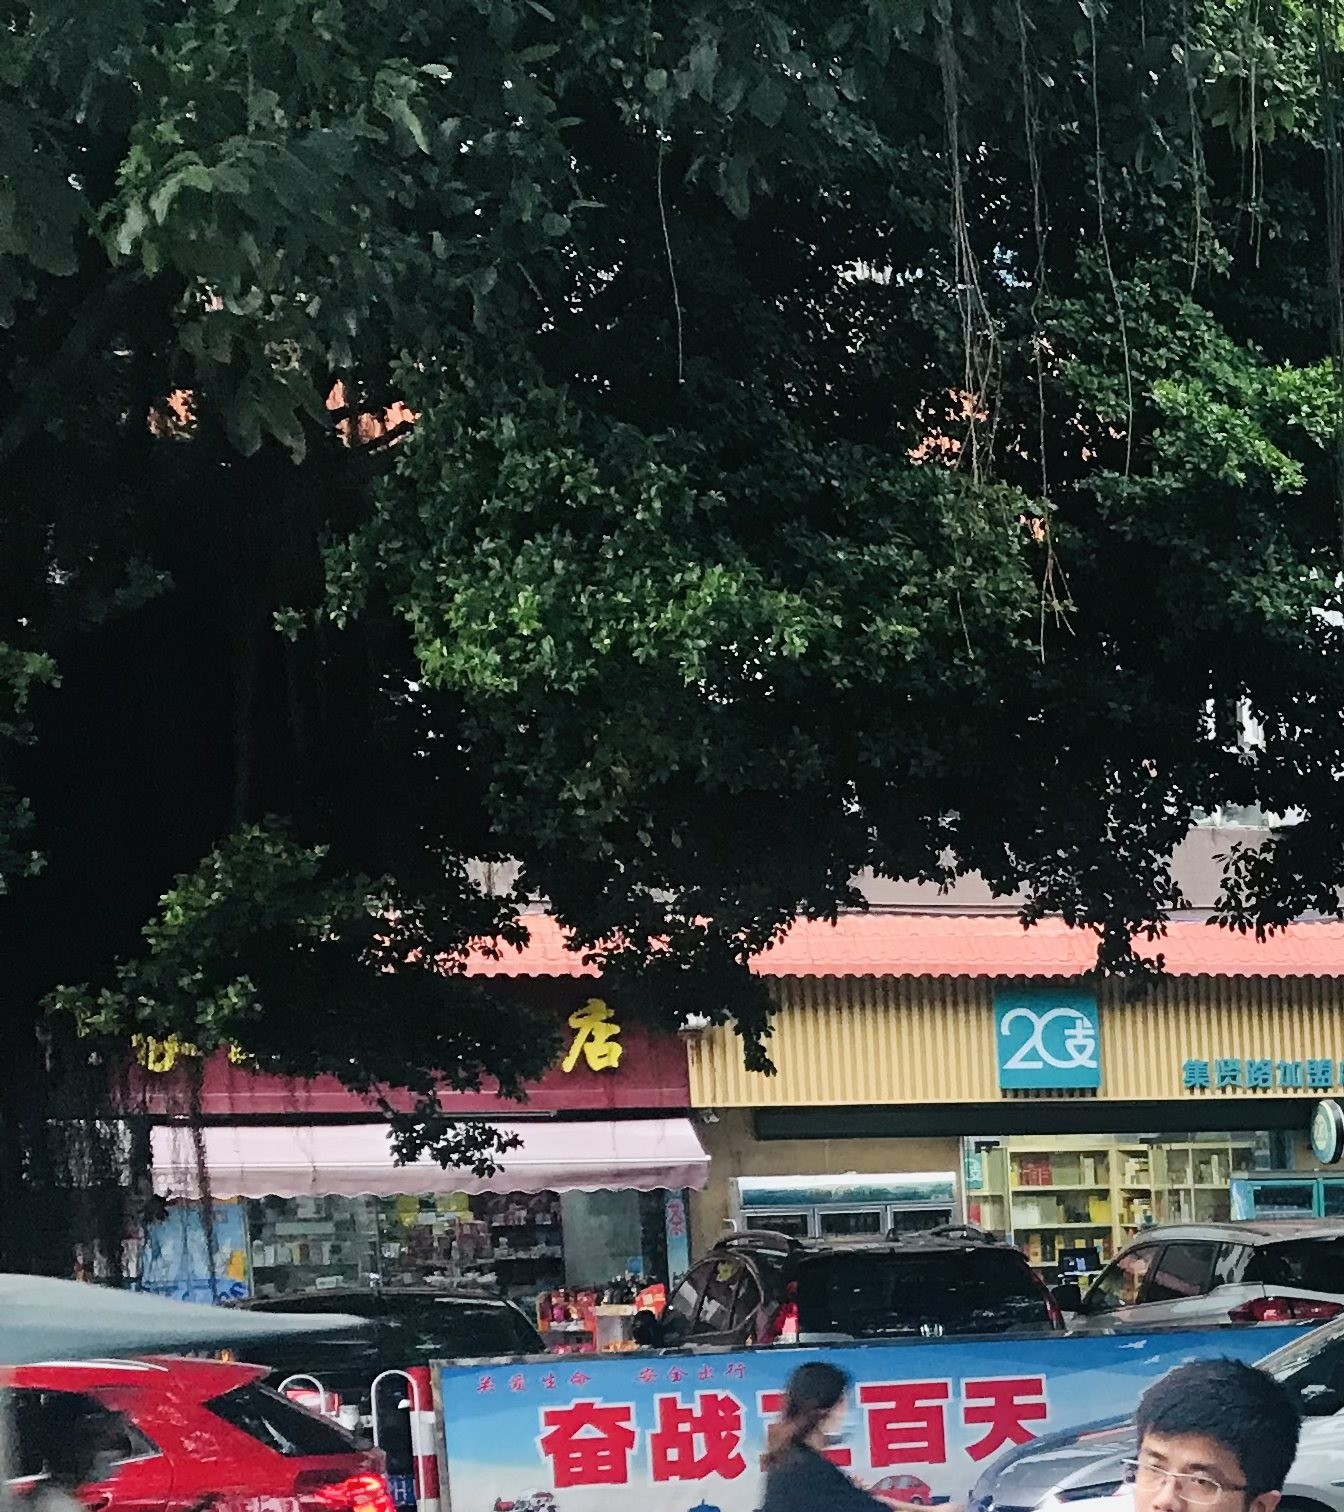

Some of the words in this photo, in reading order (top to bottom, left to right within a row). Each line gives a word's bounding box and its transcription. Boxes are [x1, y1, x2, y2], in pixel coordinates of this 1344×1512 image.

[564, 998, 623, 1072] 店
[635, 1361, 748, 1384] 安全出行
